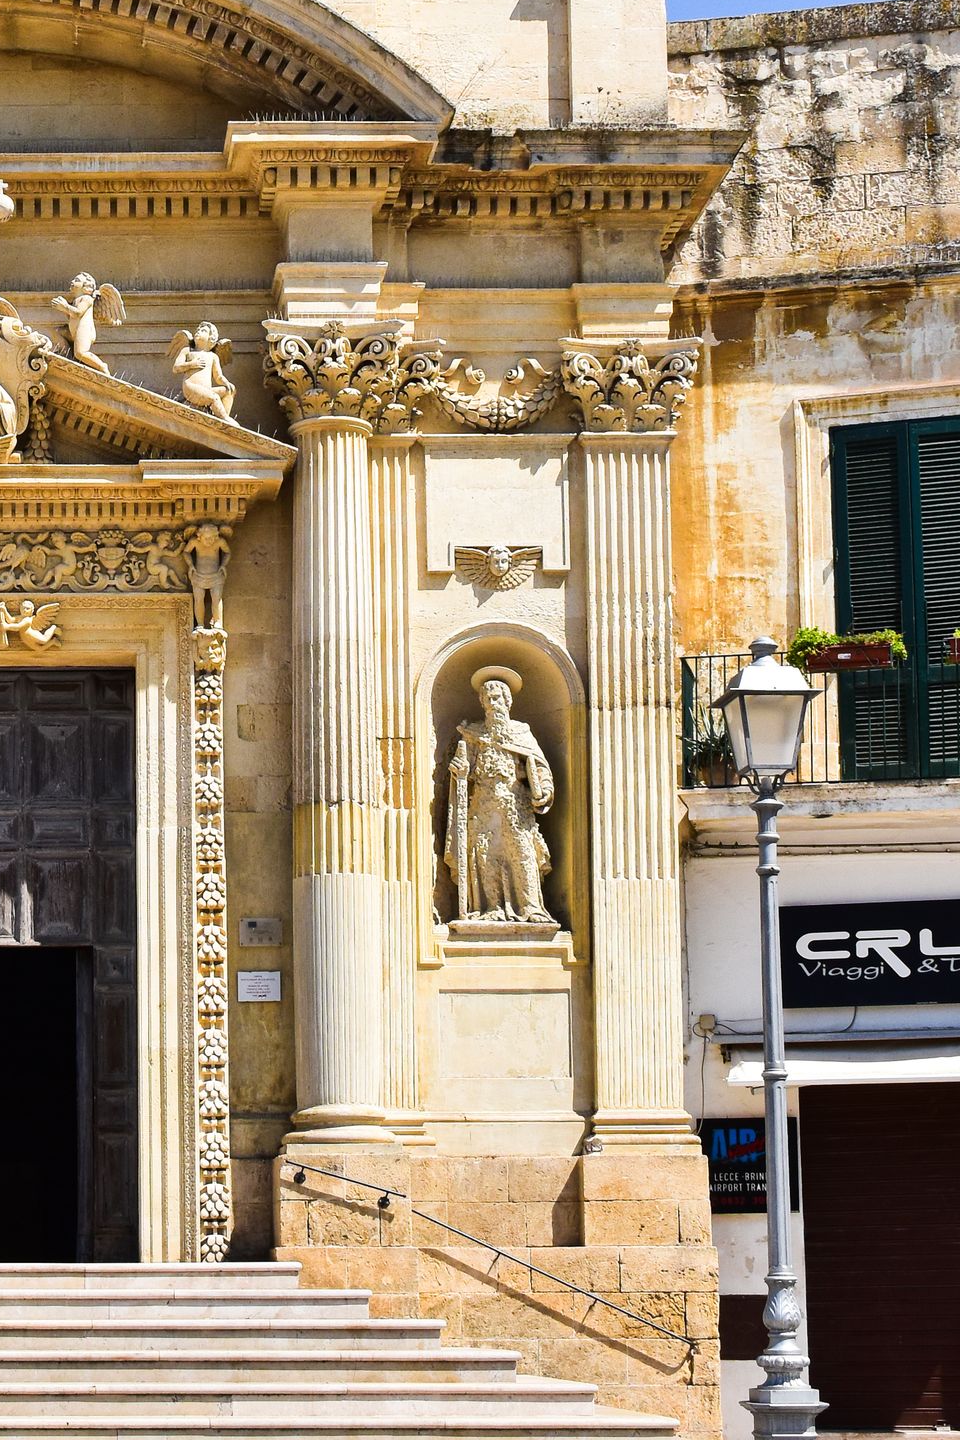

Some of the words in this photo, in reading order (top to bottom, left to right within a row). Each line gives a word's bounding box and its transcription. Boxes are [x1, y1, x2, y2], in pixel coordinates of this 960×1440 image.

[798, 961, 886, 981] Viaggi
[917, 958, 940, 973] &
[714, 1171, 740, 1182] LECCE
